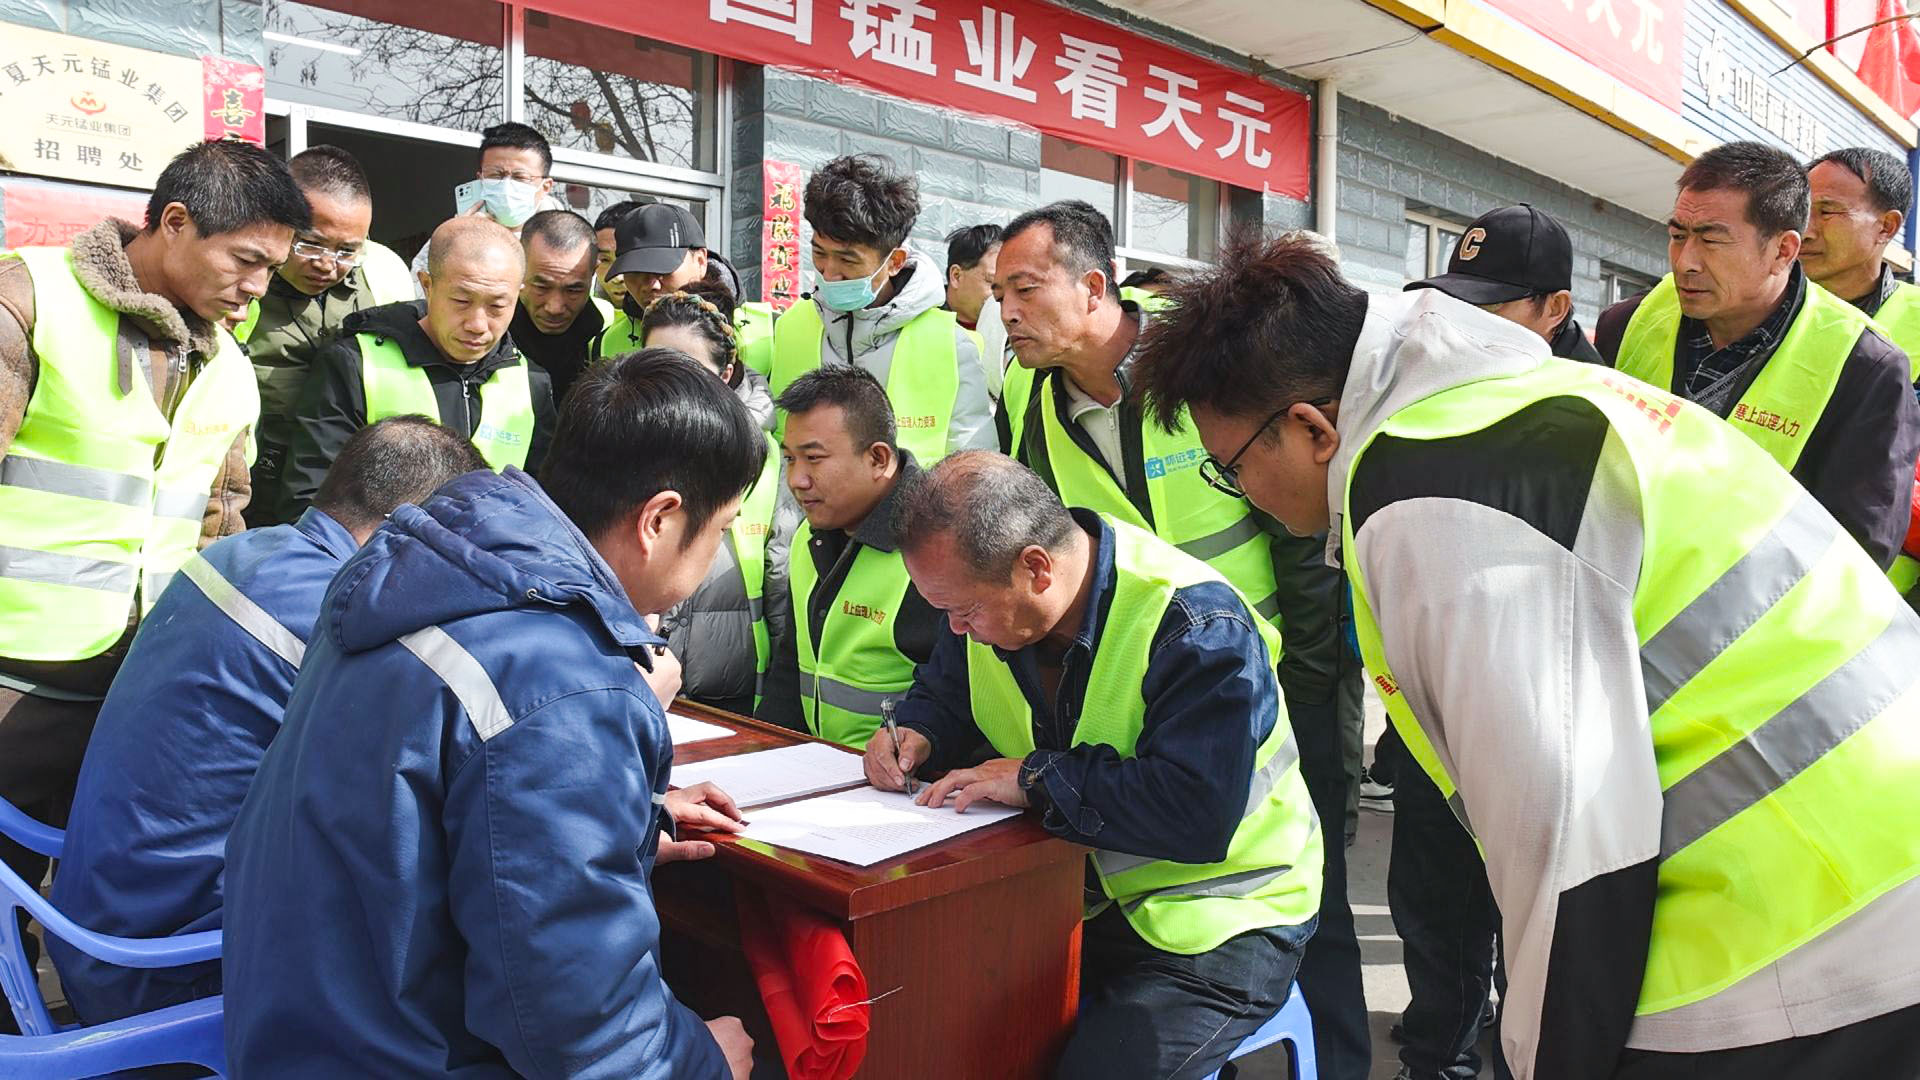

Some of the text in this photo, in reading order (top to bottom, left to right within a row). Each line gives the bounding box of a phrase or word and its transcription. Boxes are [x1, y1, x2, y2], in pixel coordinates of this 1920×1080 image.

[2, 53, 188, 123] 夏天元锰业集团
[46, 113, 131, 137] 天元锰业集团
[210, 88, 256, 141] 喜
[34, 138, 143, 171] 招聘处
[1460, 228, 1486, 260] C
[1734, 403, 1801, 437] 塞上应理人力
